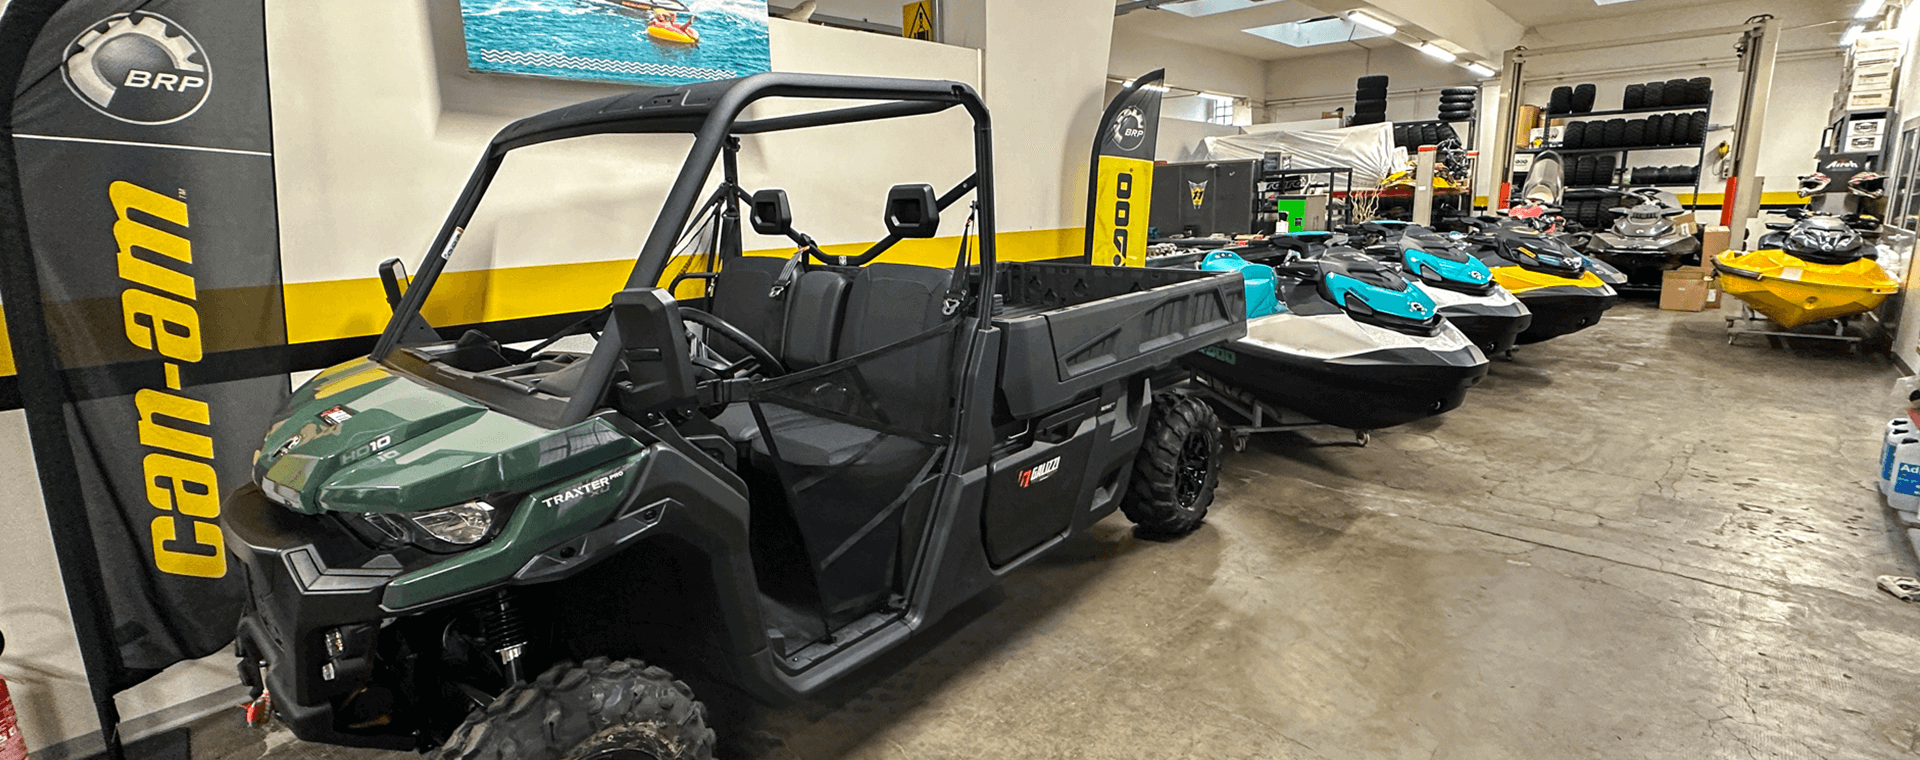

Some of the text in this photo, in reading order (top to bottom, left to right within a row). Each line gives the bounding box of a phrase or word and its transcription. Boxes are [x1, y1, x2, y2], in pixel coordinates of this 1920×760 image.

[124, 69, 204, 92] BRP
[1124, 128, 1144, 139] BRP
[109, 180, 228, 578] can-am
[341, 435, 391, 465] HD10
[542, 477, 610, 508] TRAXTER
